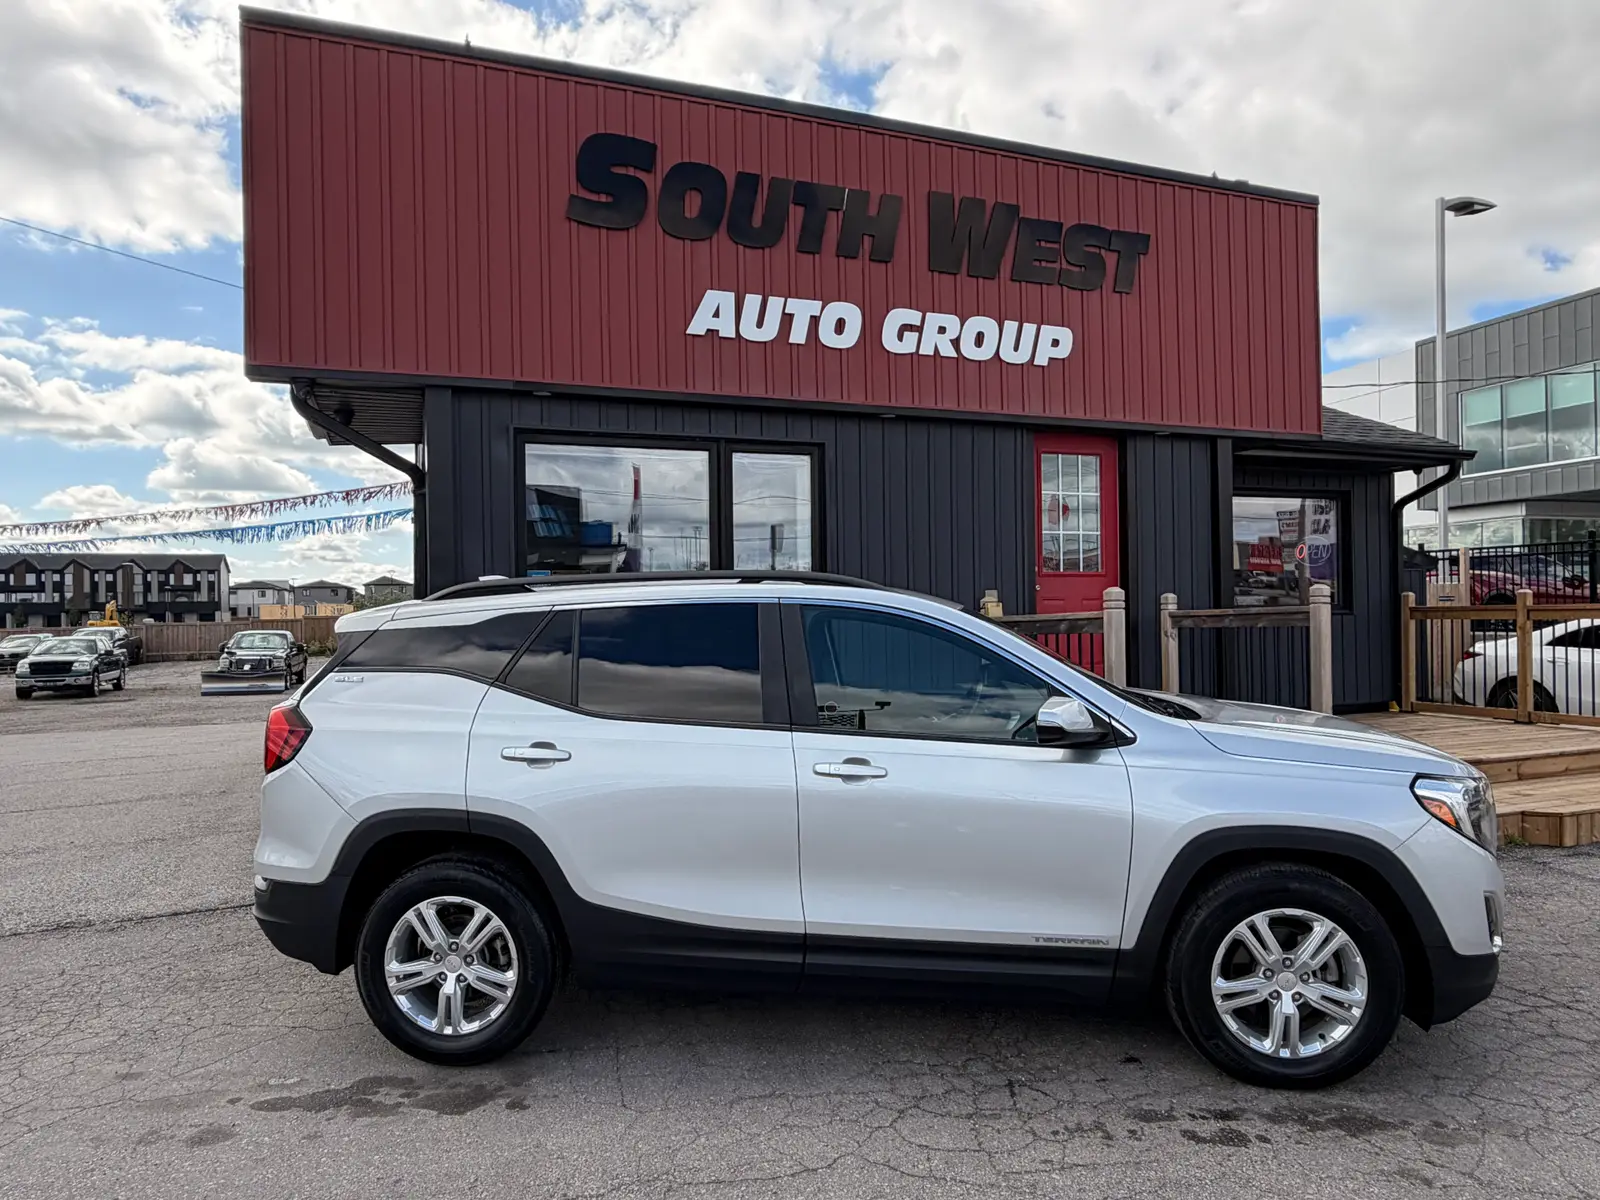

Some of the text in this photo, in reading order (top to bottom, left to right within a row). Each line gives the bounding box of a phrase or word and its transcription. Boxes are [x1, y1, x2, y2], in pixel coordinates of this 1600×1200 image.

[566, 132, 1151, 294] SOUTH WEST
[685, 289, 1074, 367] AUTO GROUP
[1295, 543, 1328, 559] OPEN
[1031, 936, 1110, 946] TERRAIN
